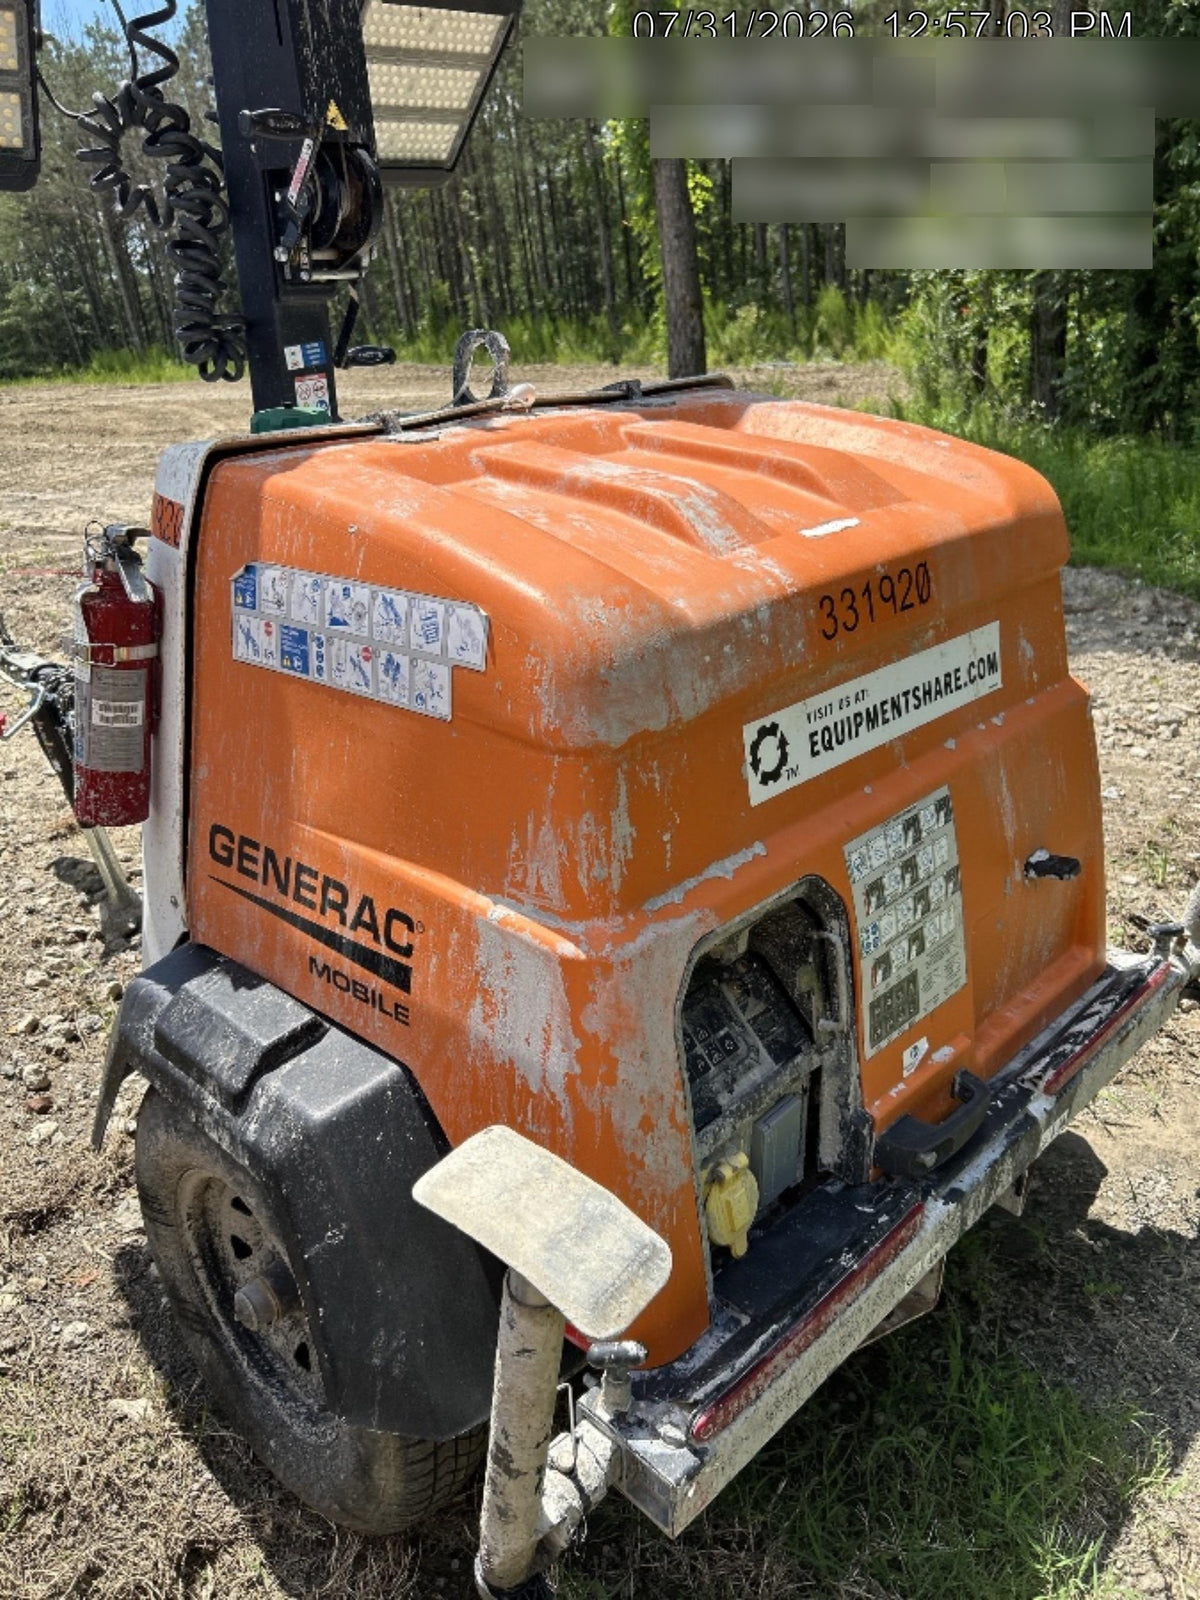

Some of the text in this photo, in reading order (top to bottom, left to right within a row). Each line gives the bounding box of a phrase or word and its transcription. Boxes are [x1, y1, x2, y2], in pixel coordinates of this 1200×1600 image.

[819, 561, 932, 640] 331920
[806, 702, 833, 724] VISIT
[808, 651, 998, 758] EQUIPMENTSHARE.COM
[209, 823, 415, 958] GENERAC
[308, 956, 411, 1027] MOBILE
